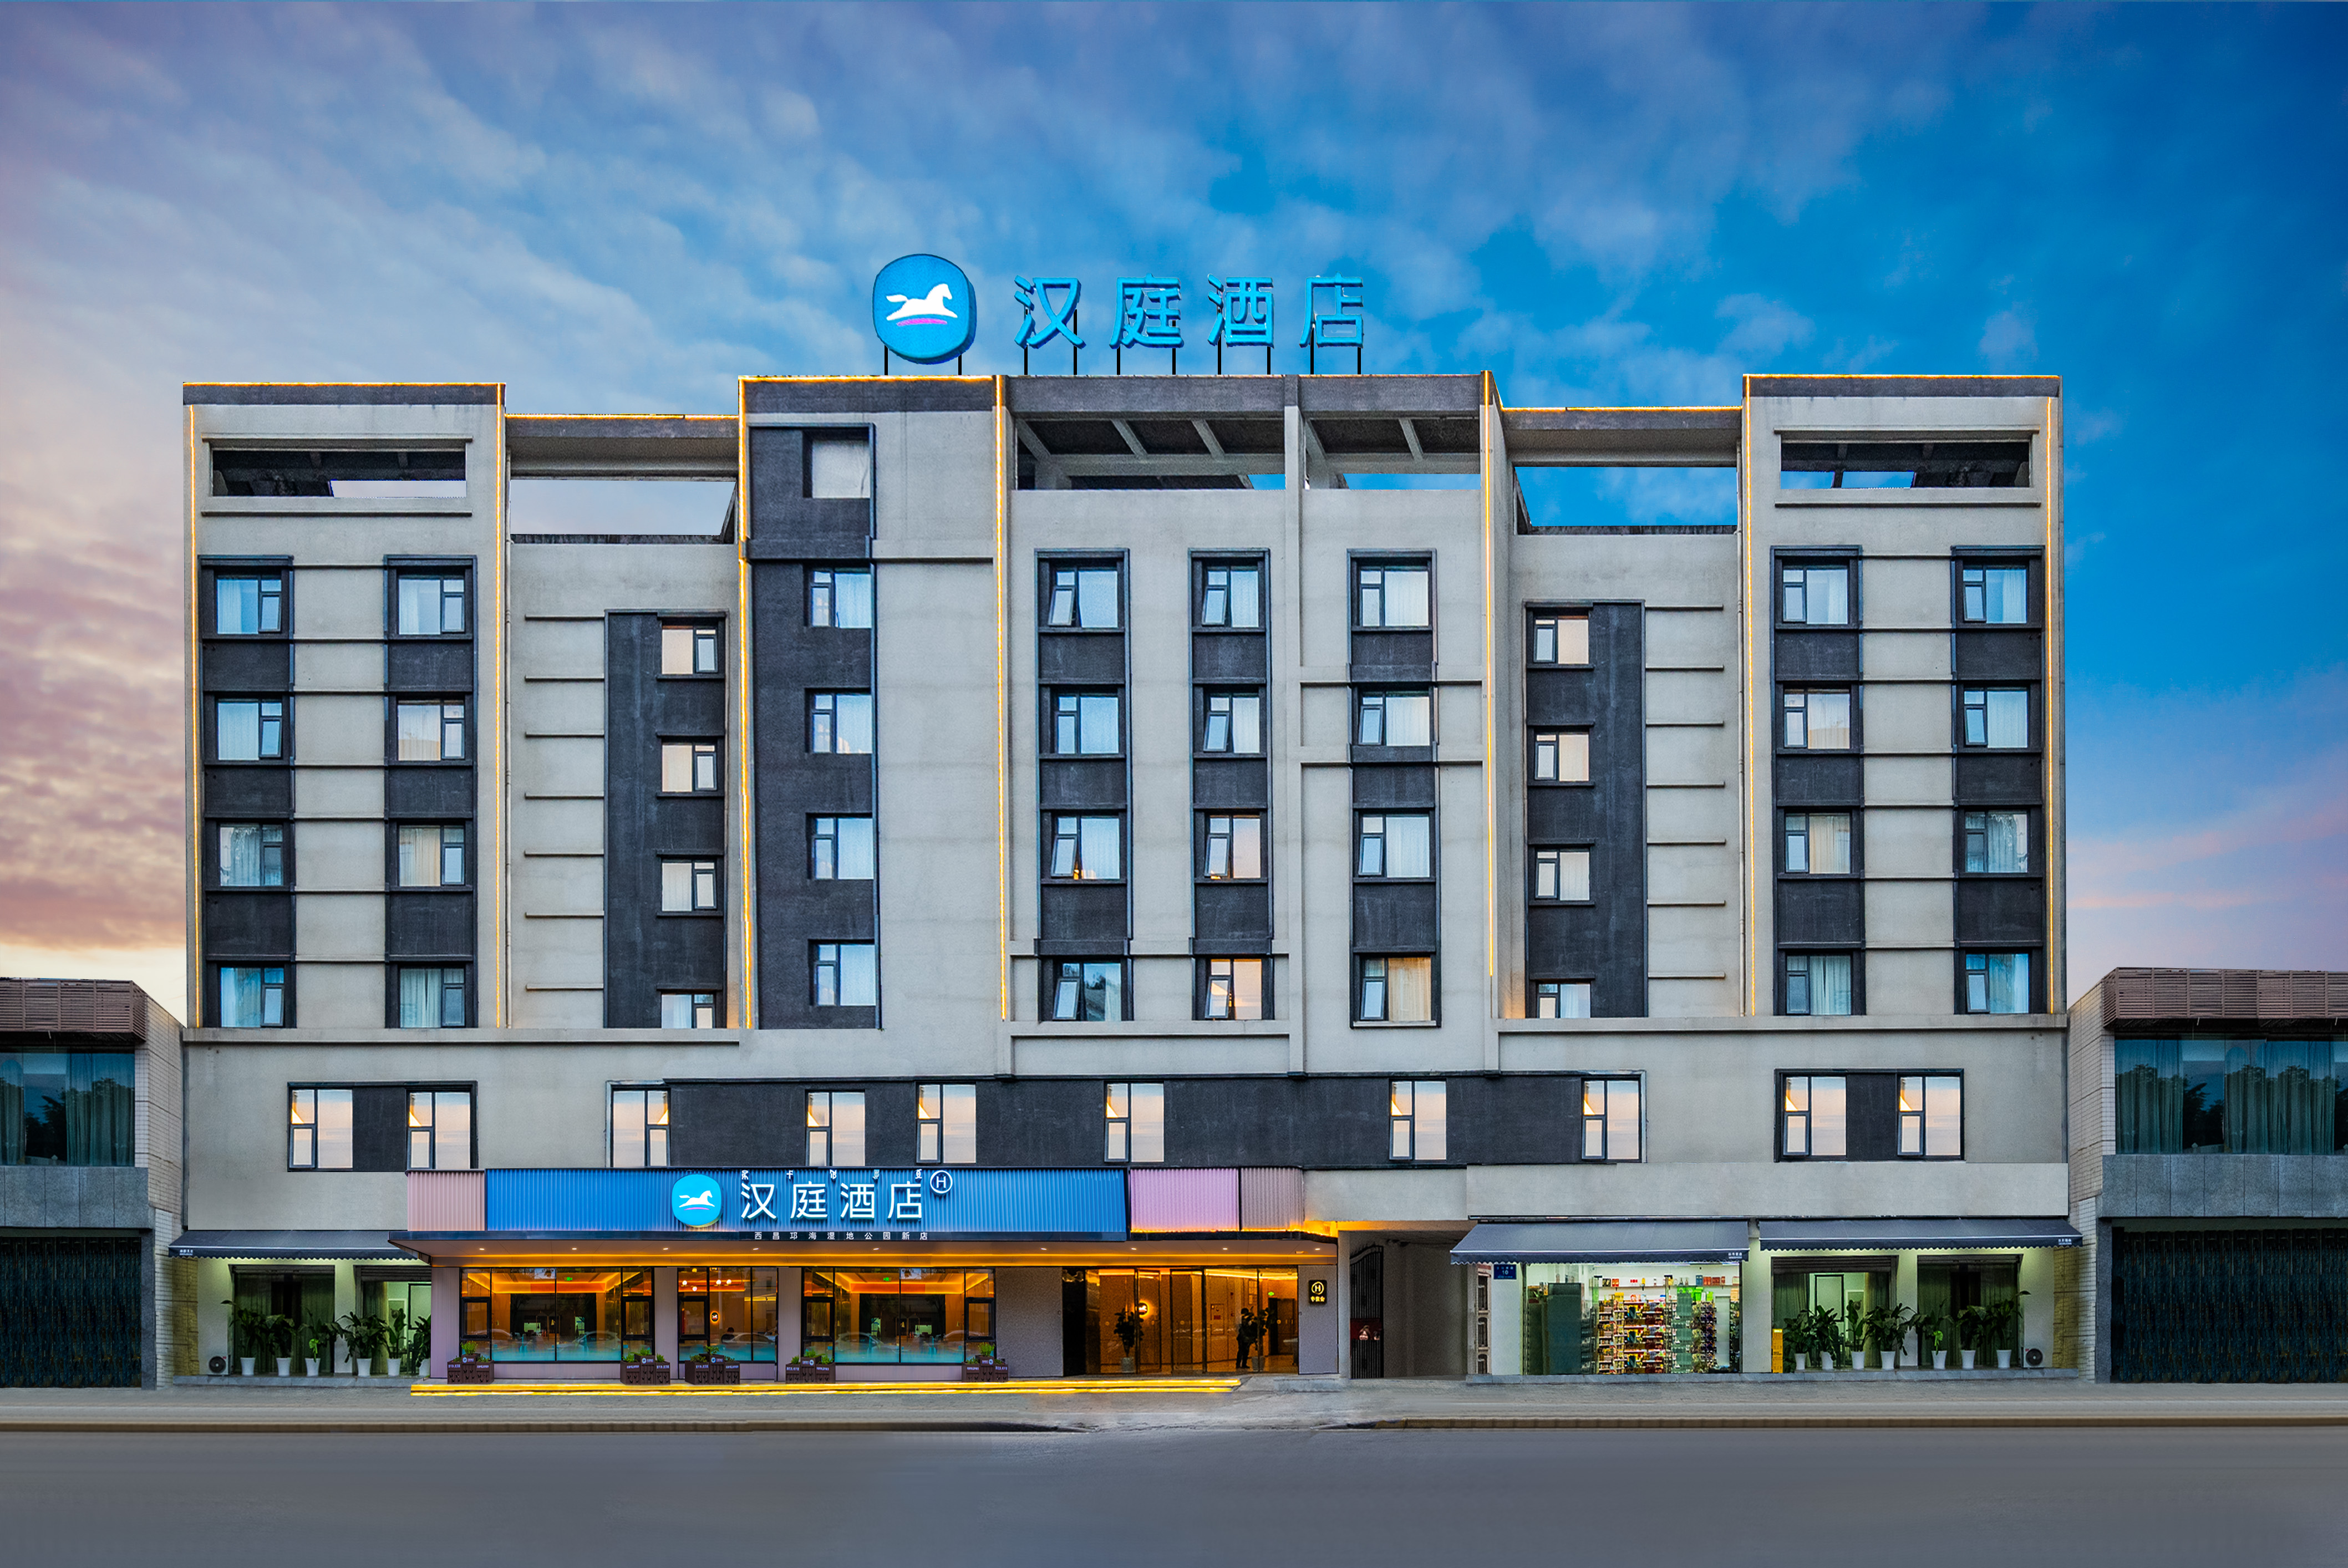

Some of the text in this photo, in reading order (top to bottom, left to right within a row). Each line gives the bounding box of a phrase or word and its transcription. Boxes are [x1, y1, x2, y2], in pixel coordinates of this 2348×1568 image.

[1014, 272, 1365, 349] 汉庭酒店
[741, 1181, 922, 1219] 汉庭酒店
[755, 1231, 928, 1240] 西昌邛海湿地公园新店
